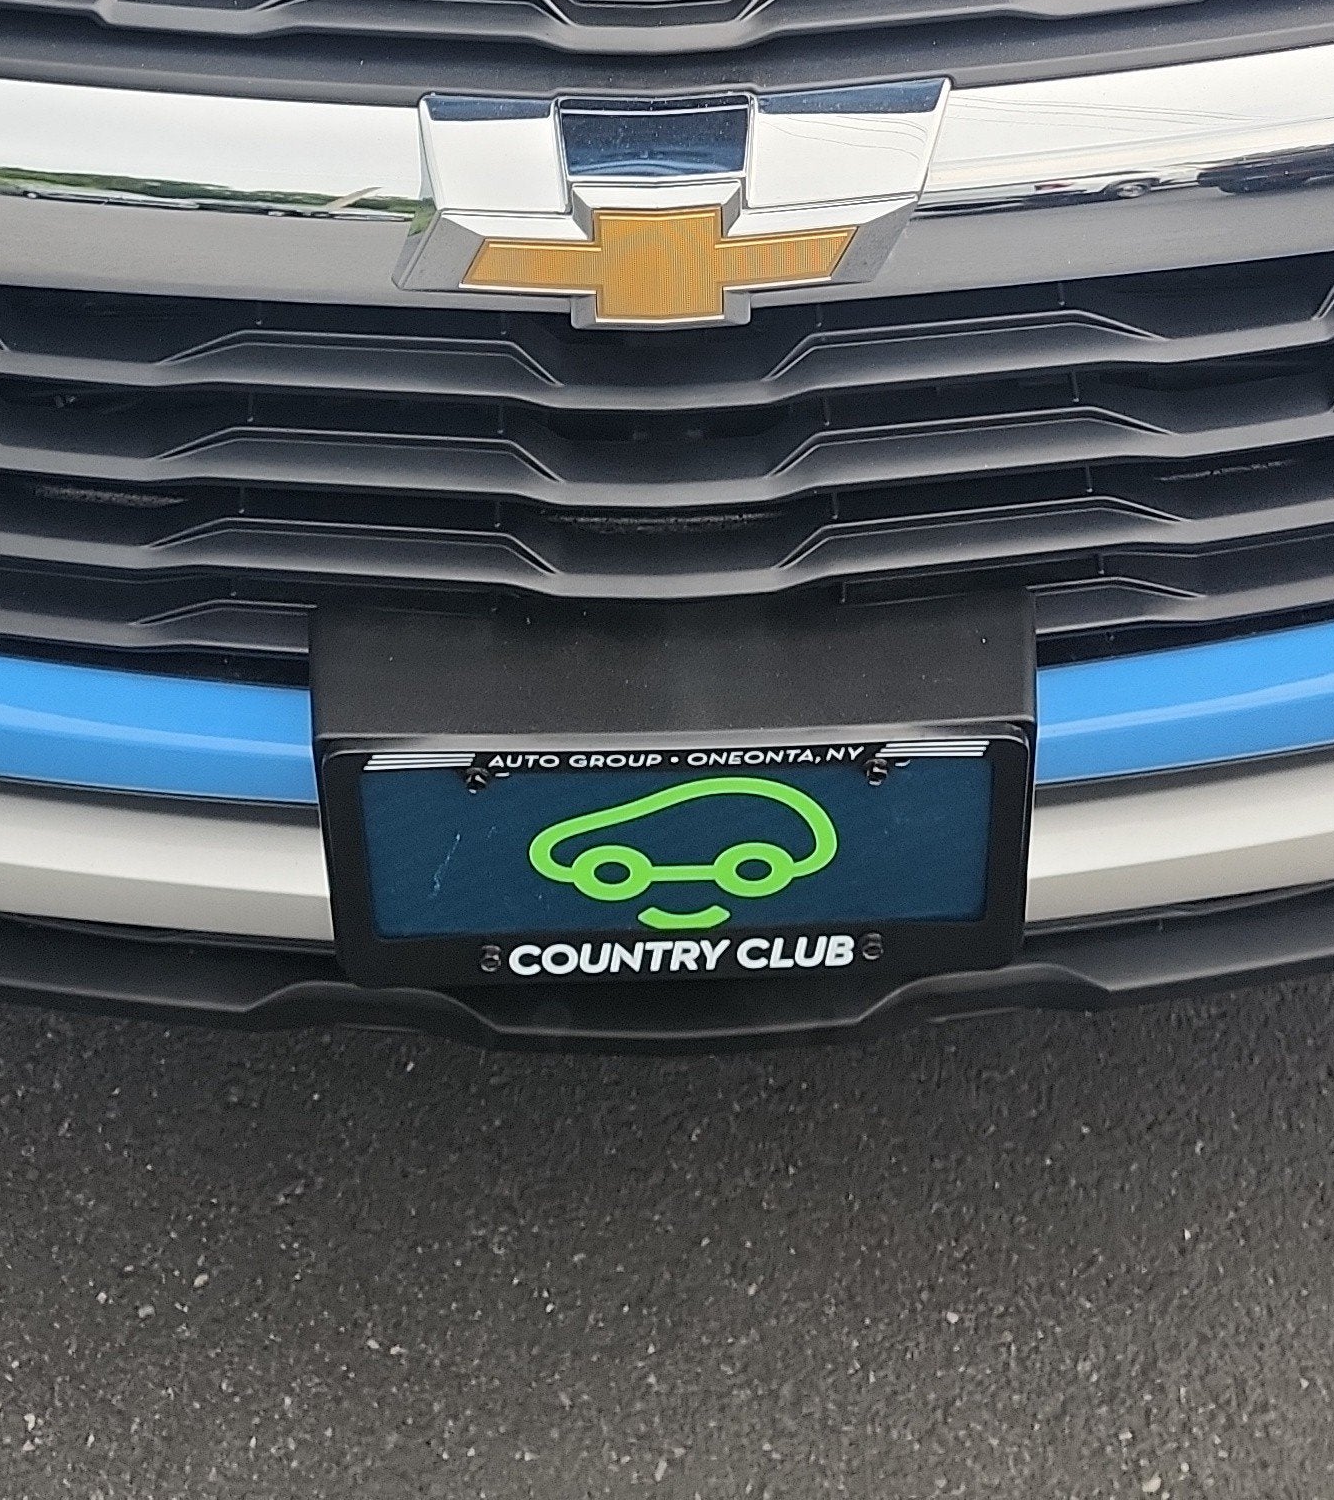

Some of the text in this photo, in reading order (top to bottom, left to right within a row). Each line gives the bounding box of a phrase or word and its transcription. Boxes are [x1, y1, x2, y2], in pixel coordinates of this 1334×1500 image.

[488, 754, 560, 768] AUTO
[568, 753, 663, 768] GROUP
[508, 935, 856, 976] COUNTRY CLUB
